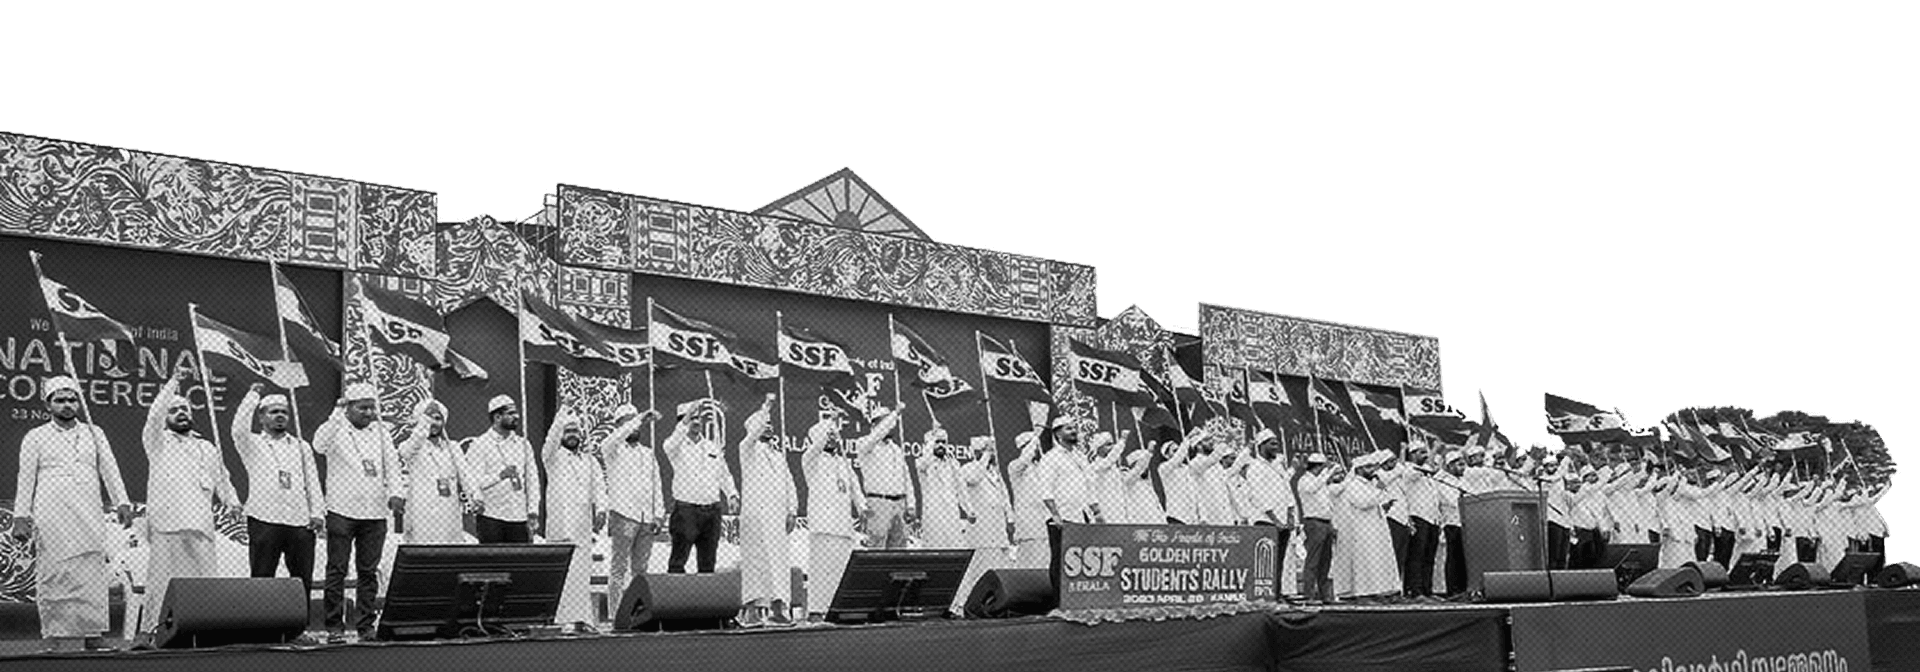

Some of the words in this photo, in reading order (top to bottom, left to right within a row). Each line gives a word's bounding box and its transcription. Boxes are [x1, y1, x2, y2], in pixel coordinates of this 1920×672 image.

[30, 318, 50, 332] We
[668, 332, 721, 359] SSF
[788, 341, 840, 368] SSF
[0, 336, 228, 384] NATINAL
[1078, 360, 1121, 383] SSF
[31, 409, 53, 421] No
[1064, 546, 1123, 577] SSF
[1139, 547, 1189, 564] GOLDEN
[1192, 547, 1229, 563] FIFTY
[1202, 567, 1249, 592] RALLY
[1123, 594, 1156, 603] 2023
[1156, 594, 1186, 604] APRIL
